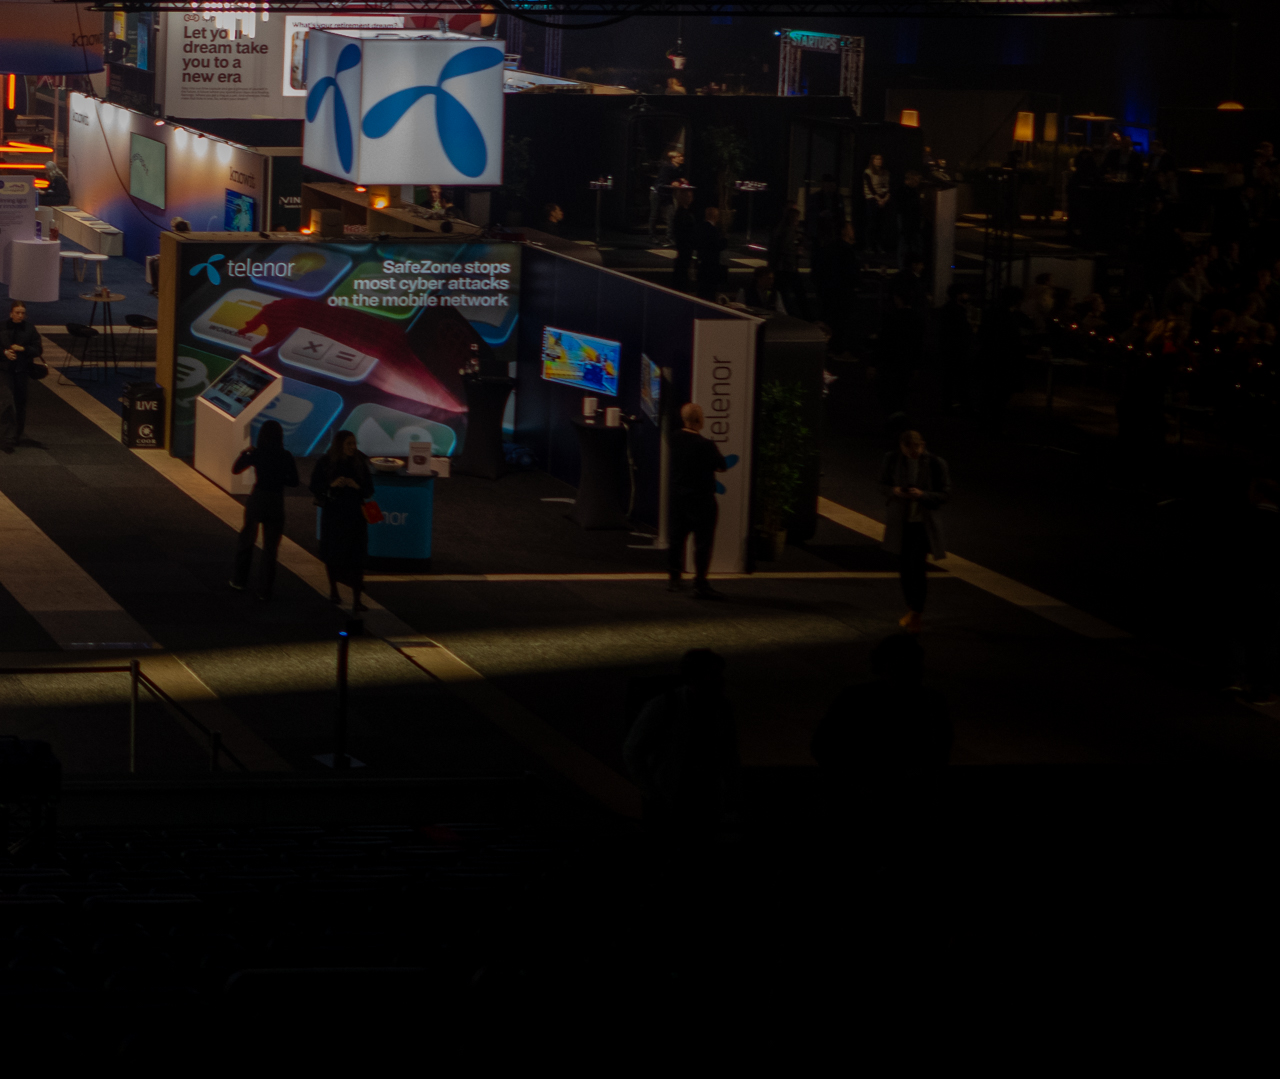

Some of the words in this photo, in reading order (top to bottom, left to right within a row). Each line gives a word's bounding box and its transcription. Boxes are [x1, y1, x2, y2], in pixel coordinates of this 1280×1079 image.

[184, 25, 207, 39] Let
[183, 40, 232, 54] dream
[235, 41, 269, 54] take
[182, 57, 210, 71] you
[214, 56, 229, 68] to
[232, 58, 242, 69] a
[182, 72, 214, 83] new
[217, 72, 242, 83] era
[226, 258, 296, 277] telenor
[383, 260, 462, 274] SafeZone
[463, 261, 511, 277] stops
[353, 278, 397, 290] most
[398, 277, 446, 293] cyber
[447, 277, 510, 290] attacks
[327, 296, 350, 307] on
[351, 293, 380, 307] the
[381, 293, 438, 307] mobile
[439, 293, 509, 307] network
[136, 401, 159, 411] LIVE
